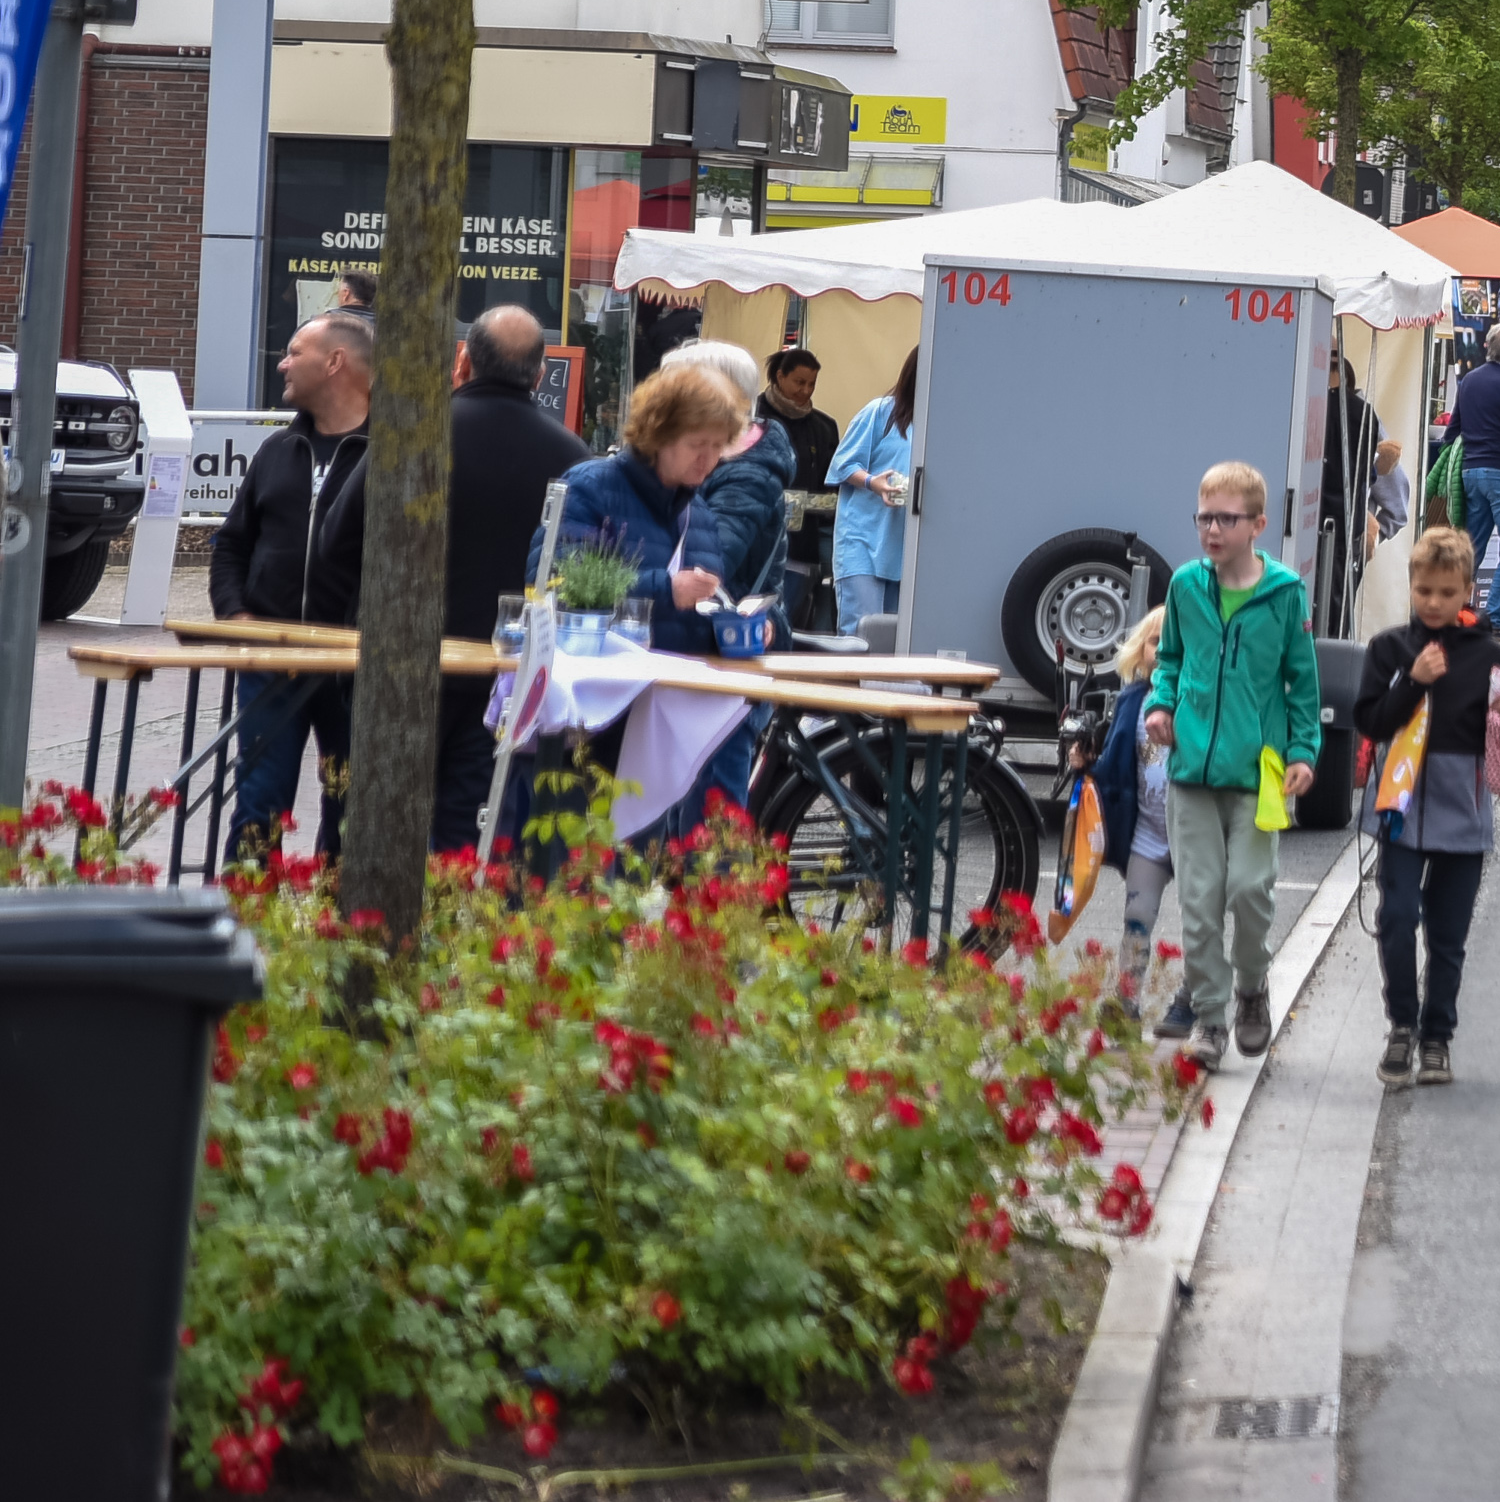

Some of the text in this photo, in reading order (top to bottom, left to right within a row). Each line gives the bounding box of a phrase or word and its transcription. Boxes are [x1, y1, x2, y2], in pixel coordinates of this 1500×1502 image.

[880, 120, 921, 134] Team
[475, 238, 557, 256] BESSER.
[491, 266, 542, 281] VEEZE.
[940, 271, 1011, 306] 104
[1224, 287, 1295, 324] 104
